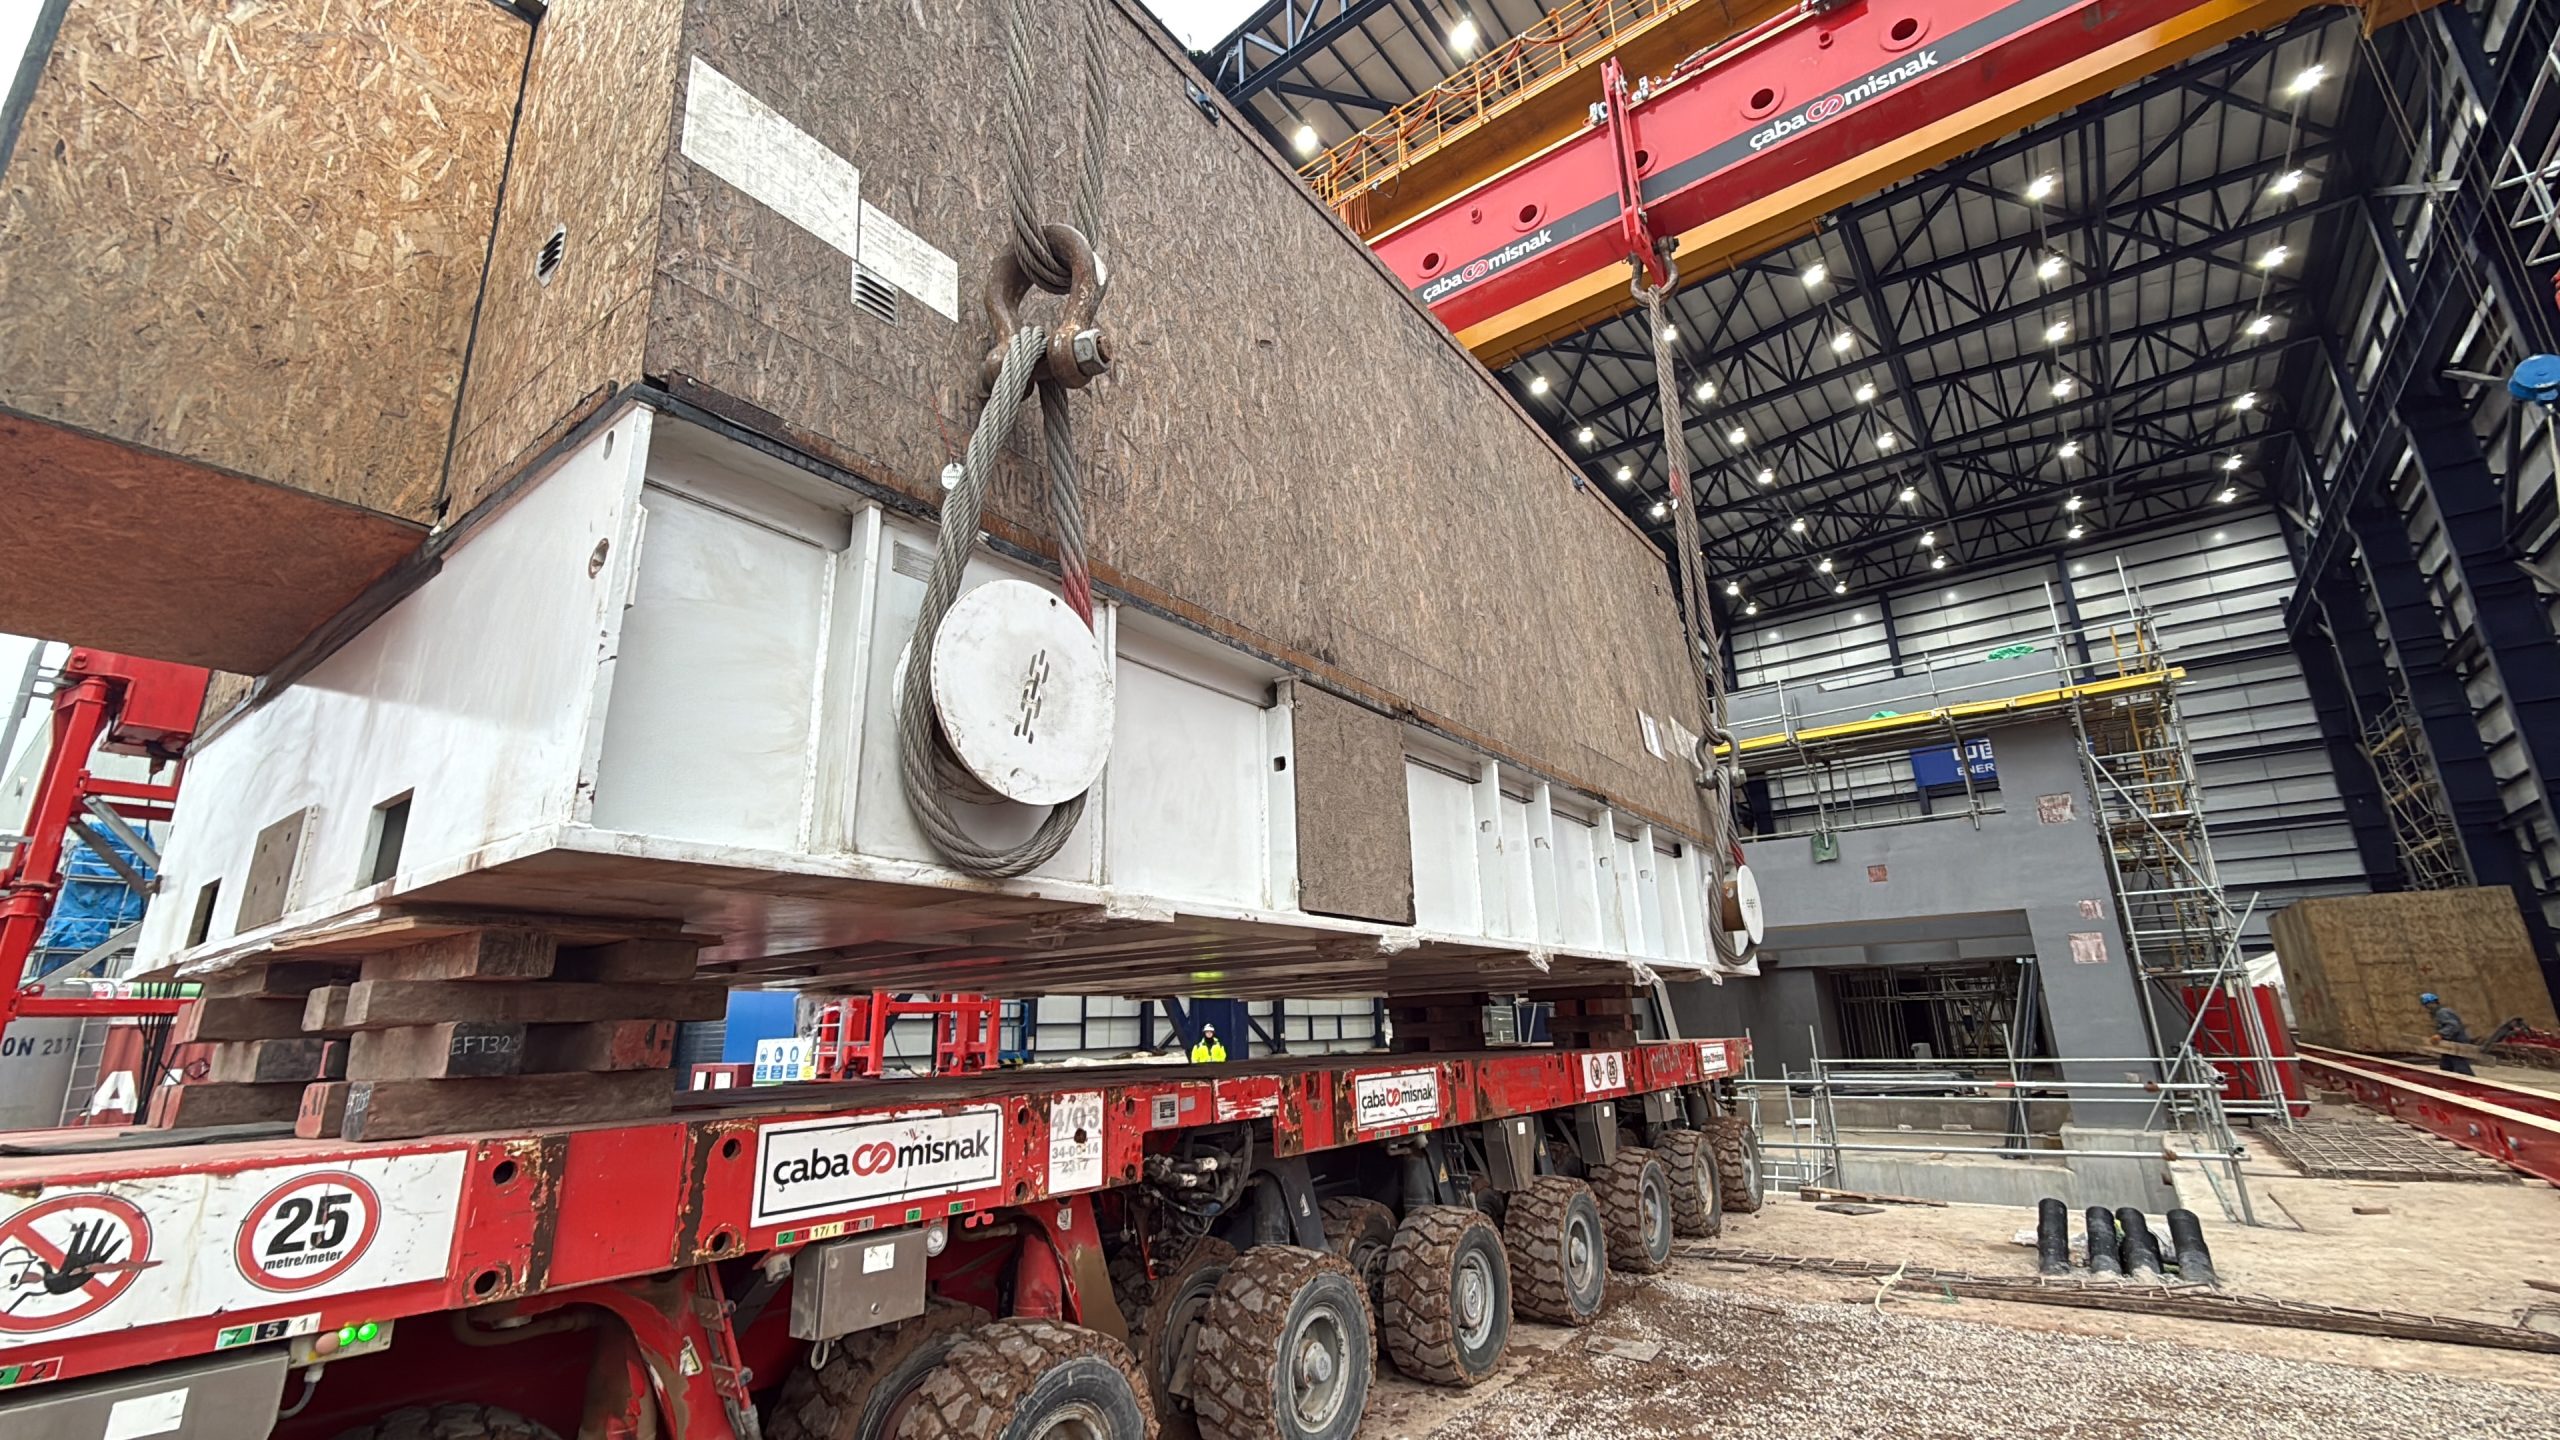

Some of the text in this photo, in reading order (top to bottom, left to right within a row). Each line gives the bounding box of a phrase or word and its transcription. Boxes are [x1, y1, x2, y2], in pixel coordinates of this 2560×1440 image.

[1749, 50, 1939, 150] çaba misnak
[1488, 229, 1552, 270] misnak
[1401, 1083, 1433, 1104] misnak
[773, 1129, 990, 1192] çaba misnak
[266, 1193, 352, 1256] 25
[263, 1250, 343, 1271] metre/meter
[265, 1322, 280, 1339] 5
[30, 1361, 48, 1380] 2
